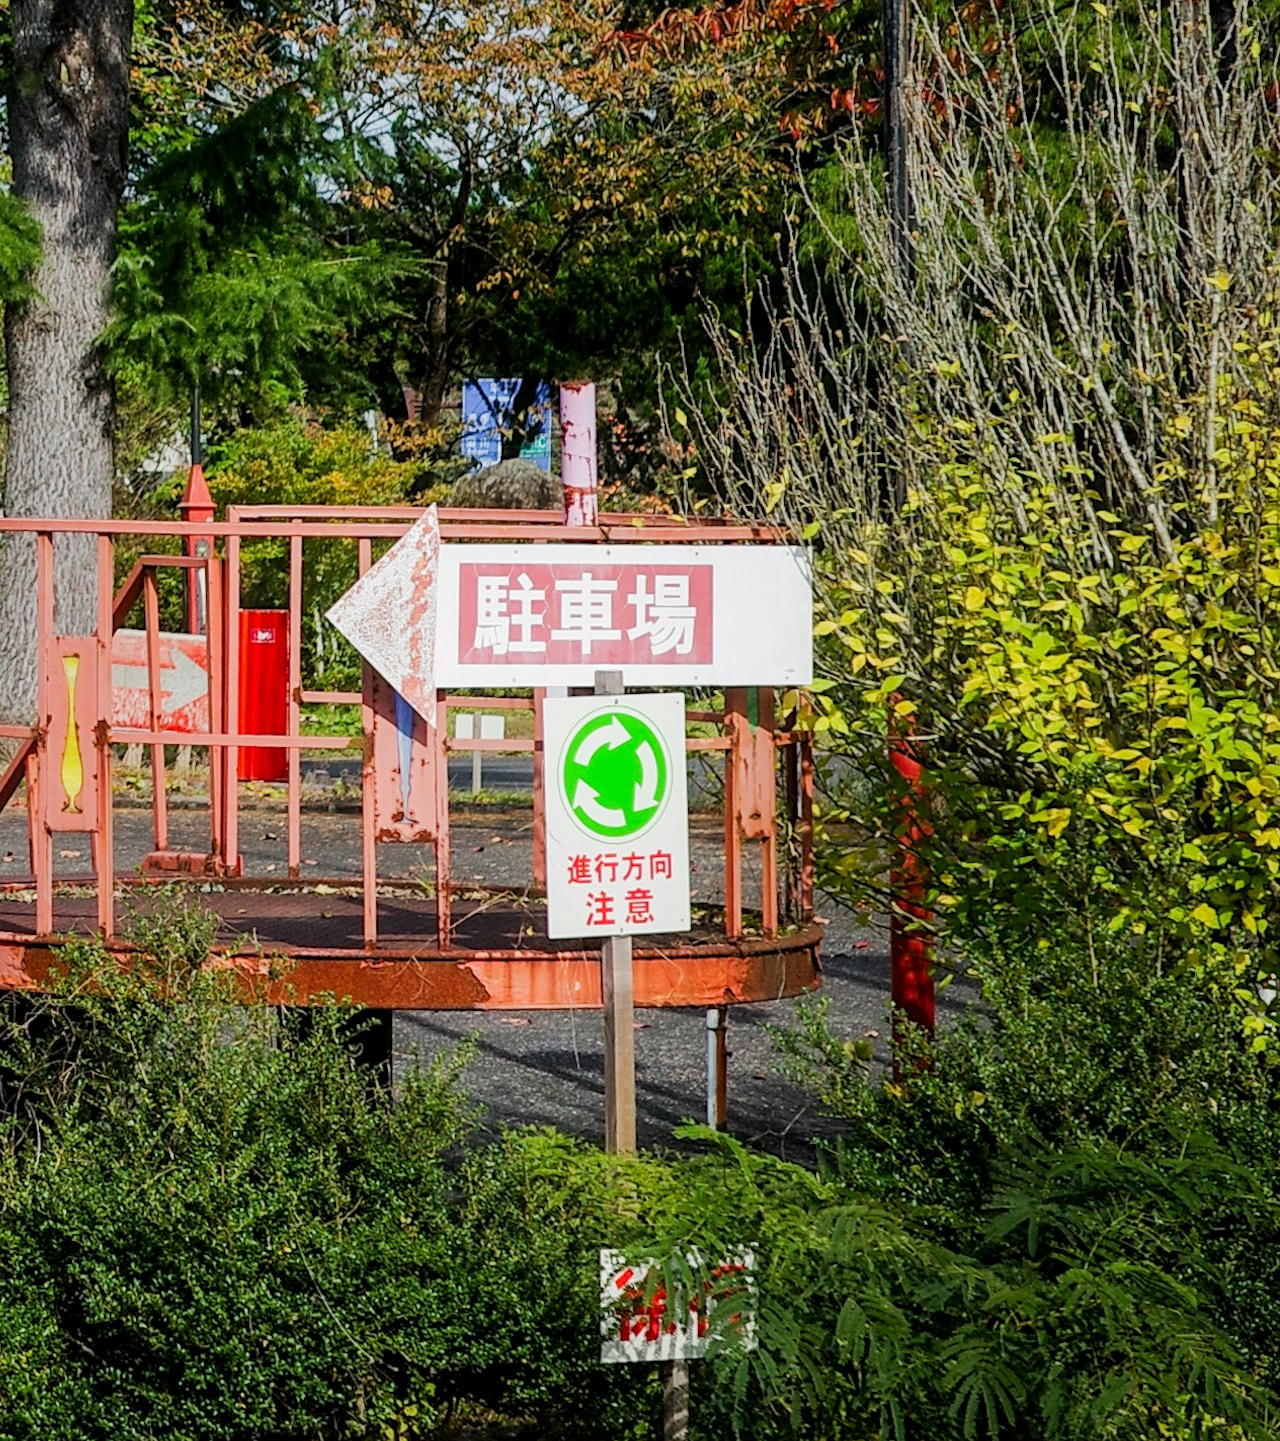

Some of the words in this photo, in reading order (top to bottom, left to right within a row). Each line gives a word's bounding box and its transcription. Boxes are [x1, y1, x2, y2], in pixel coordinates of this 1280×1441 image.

[474, 572, 697, 656] 駐車場
[567, 849, 672, 884] 進行方向
[586, 887, 655, 926] 注意
